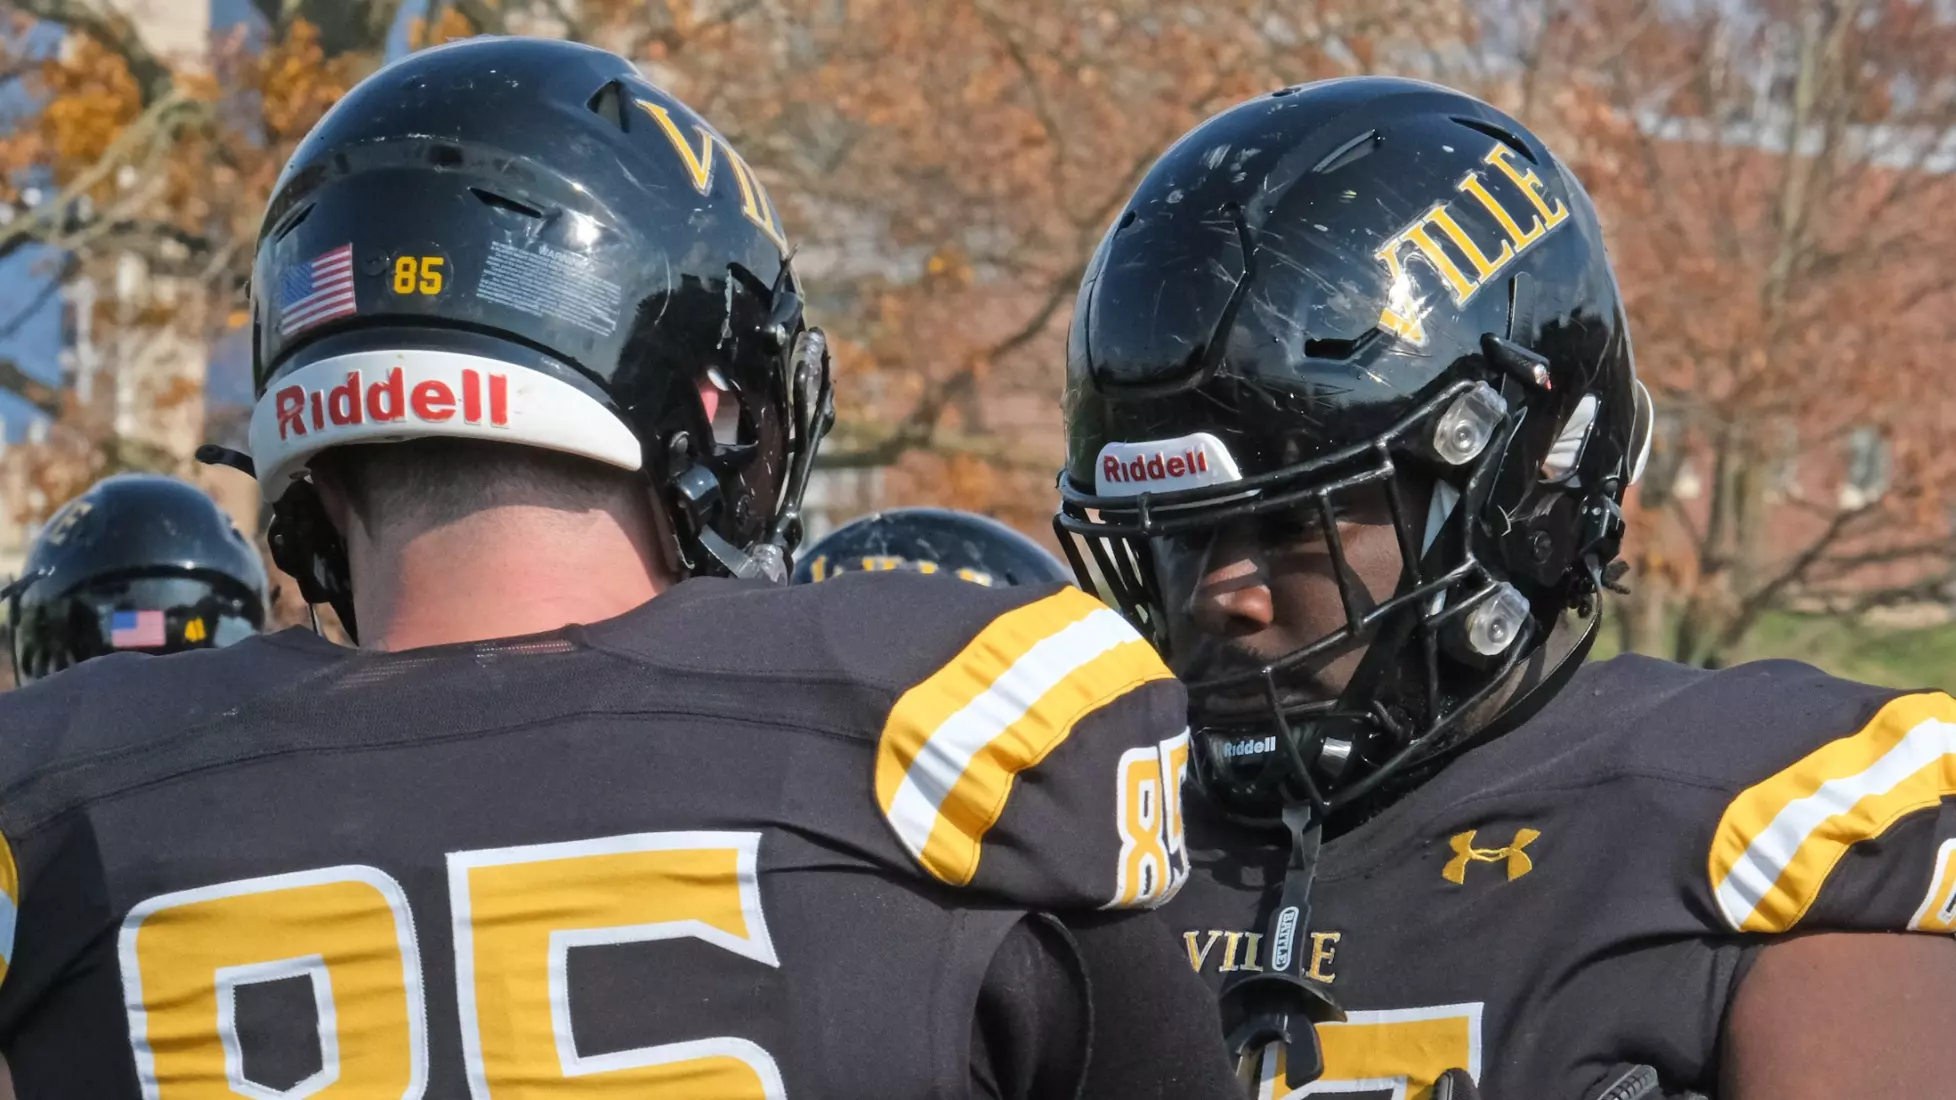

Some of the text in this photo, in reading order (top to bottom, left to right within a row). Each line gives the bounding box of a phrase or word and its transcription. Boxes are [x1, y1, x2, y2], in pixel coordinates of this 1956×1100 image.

[1374, 142, 1570, 346] VILLE
[394, 256, 445, 295] 85
[276, 366, 509, 442] Riddell
[1103, 449, 1208, 483] Riddell
[1224, 736, 1276, 757] Riddell
[1182, 929, 1342, 984] VILE
[1276, 911, 1295, 966] BATTLE
